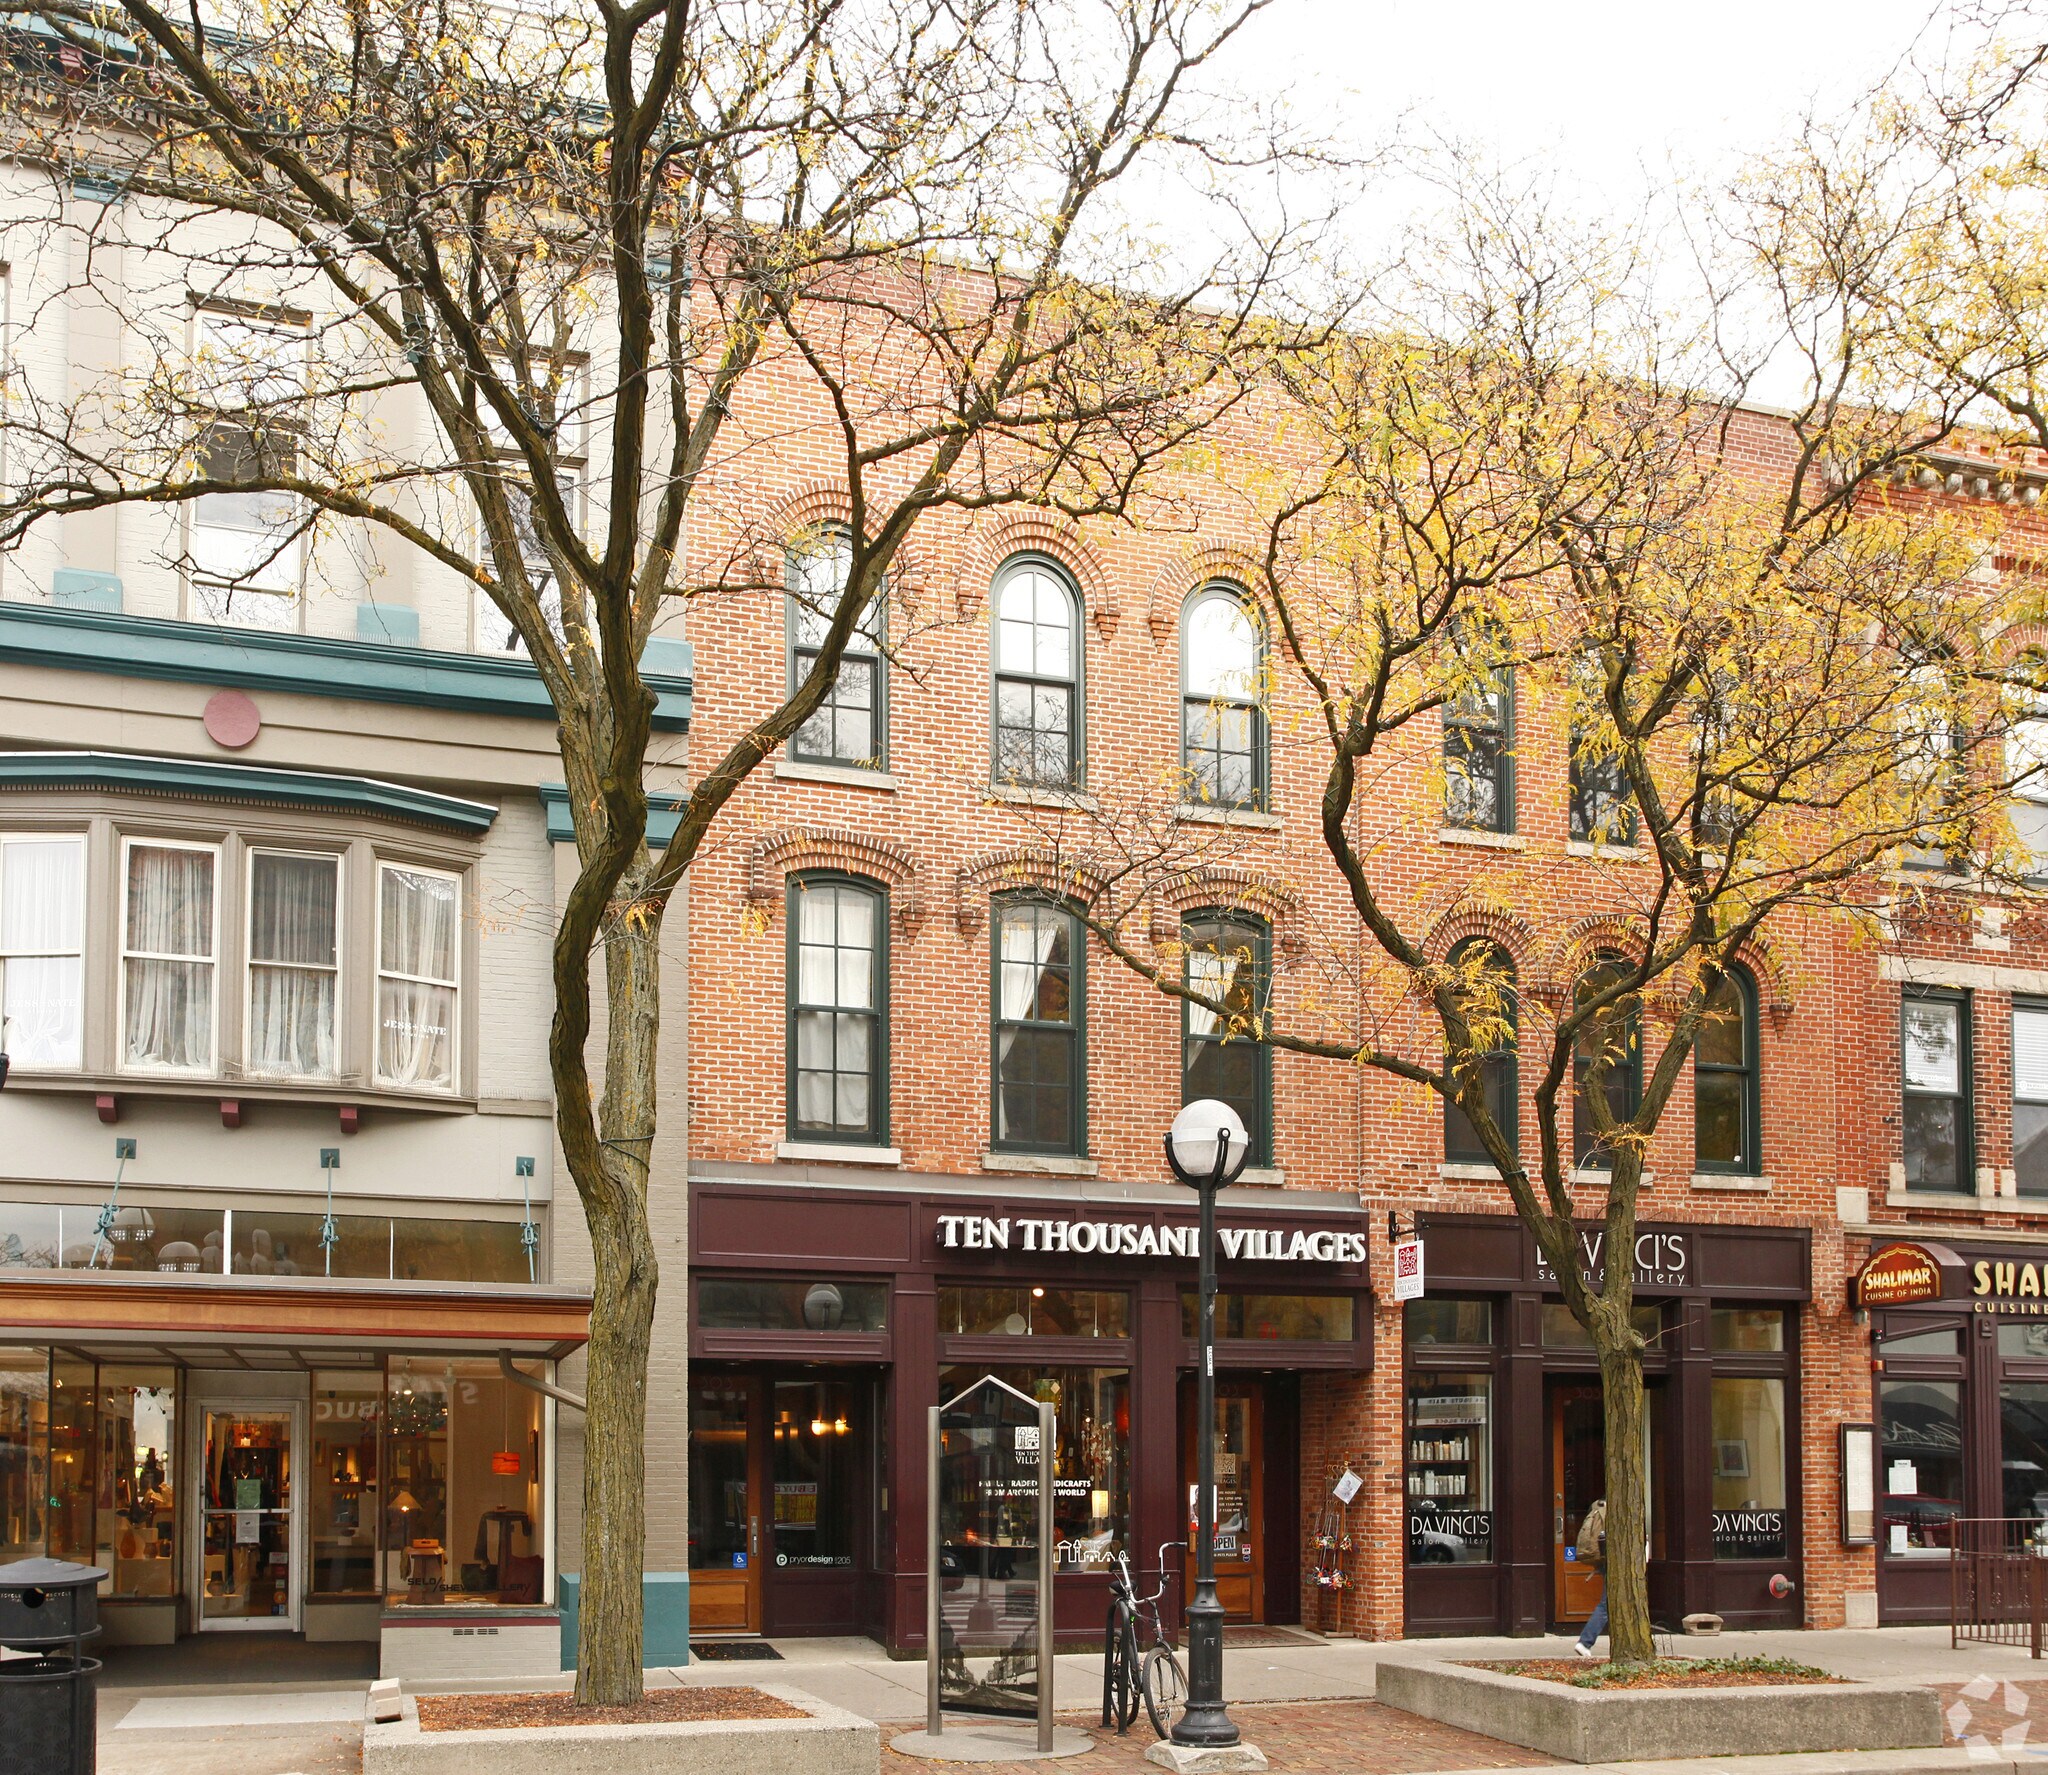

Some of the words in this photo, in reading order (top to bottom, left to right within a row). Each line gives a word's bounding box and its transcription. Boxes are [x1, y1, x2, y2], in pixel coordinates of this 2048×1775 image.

[936, 1214, 1010, 1250] TEN
[1015, 1218, 1200, 1257] THOUSAN
[1216, 1227, 1367, 1264] VILLAGES
[1581, 1231, 1686, 1272] VCI'S
[1865, 1267, 1932, 1291] SHALIMAR
[1865, 1289, 1895, 1301] CUISINE
[1897, 1288, 1908, 1298] OF
[1910, 1286, 1932, 1296] INDIA
[1057, 1488, 1087, 1497] WORLD
[1712, 1534, 1738, 1542] alon
[789, 1555, 834, 1565] pryordesign
